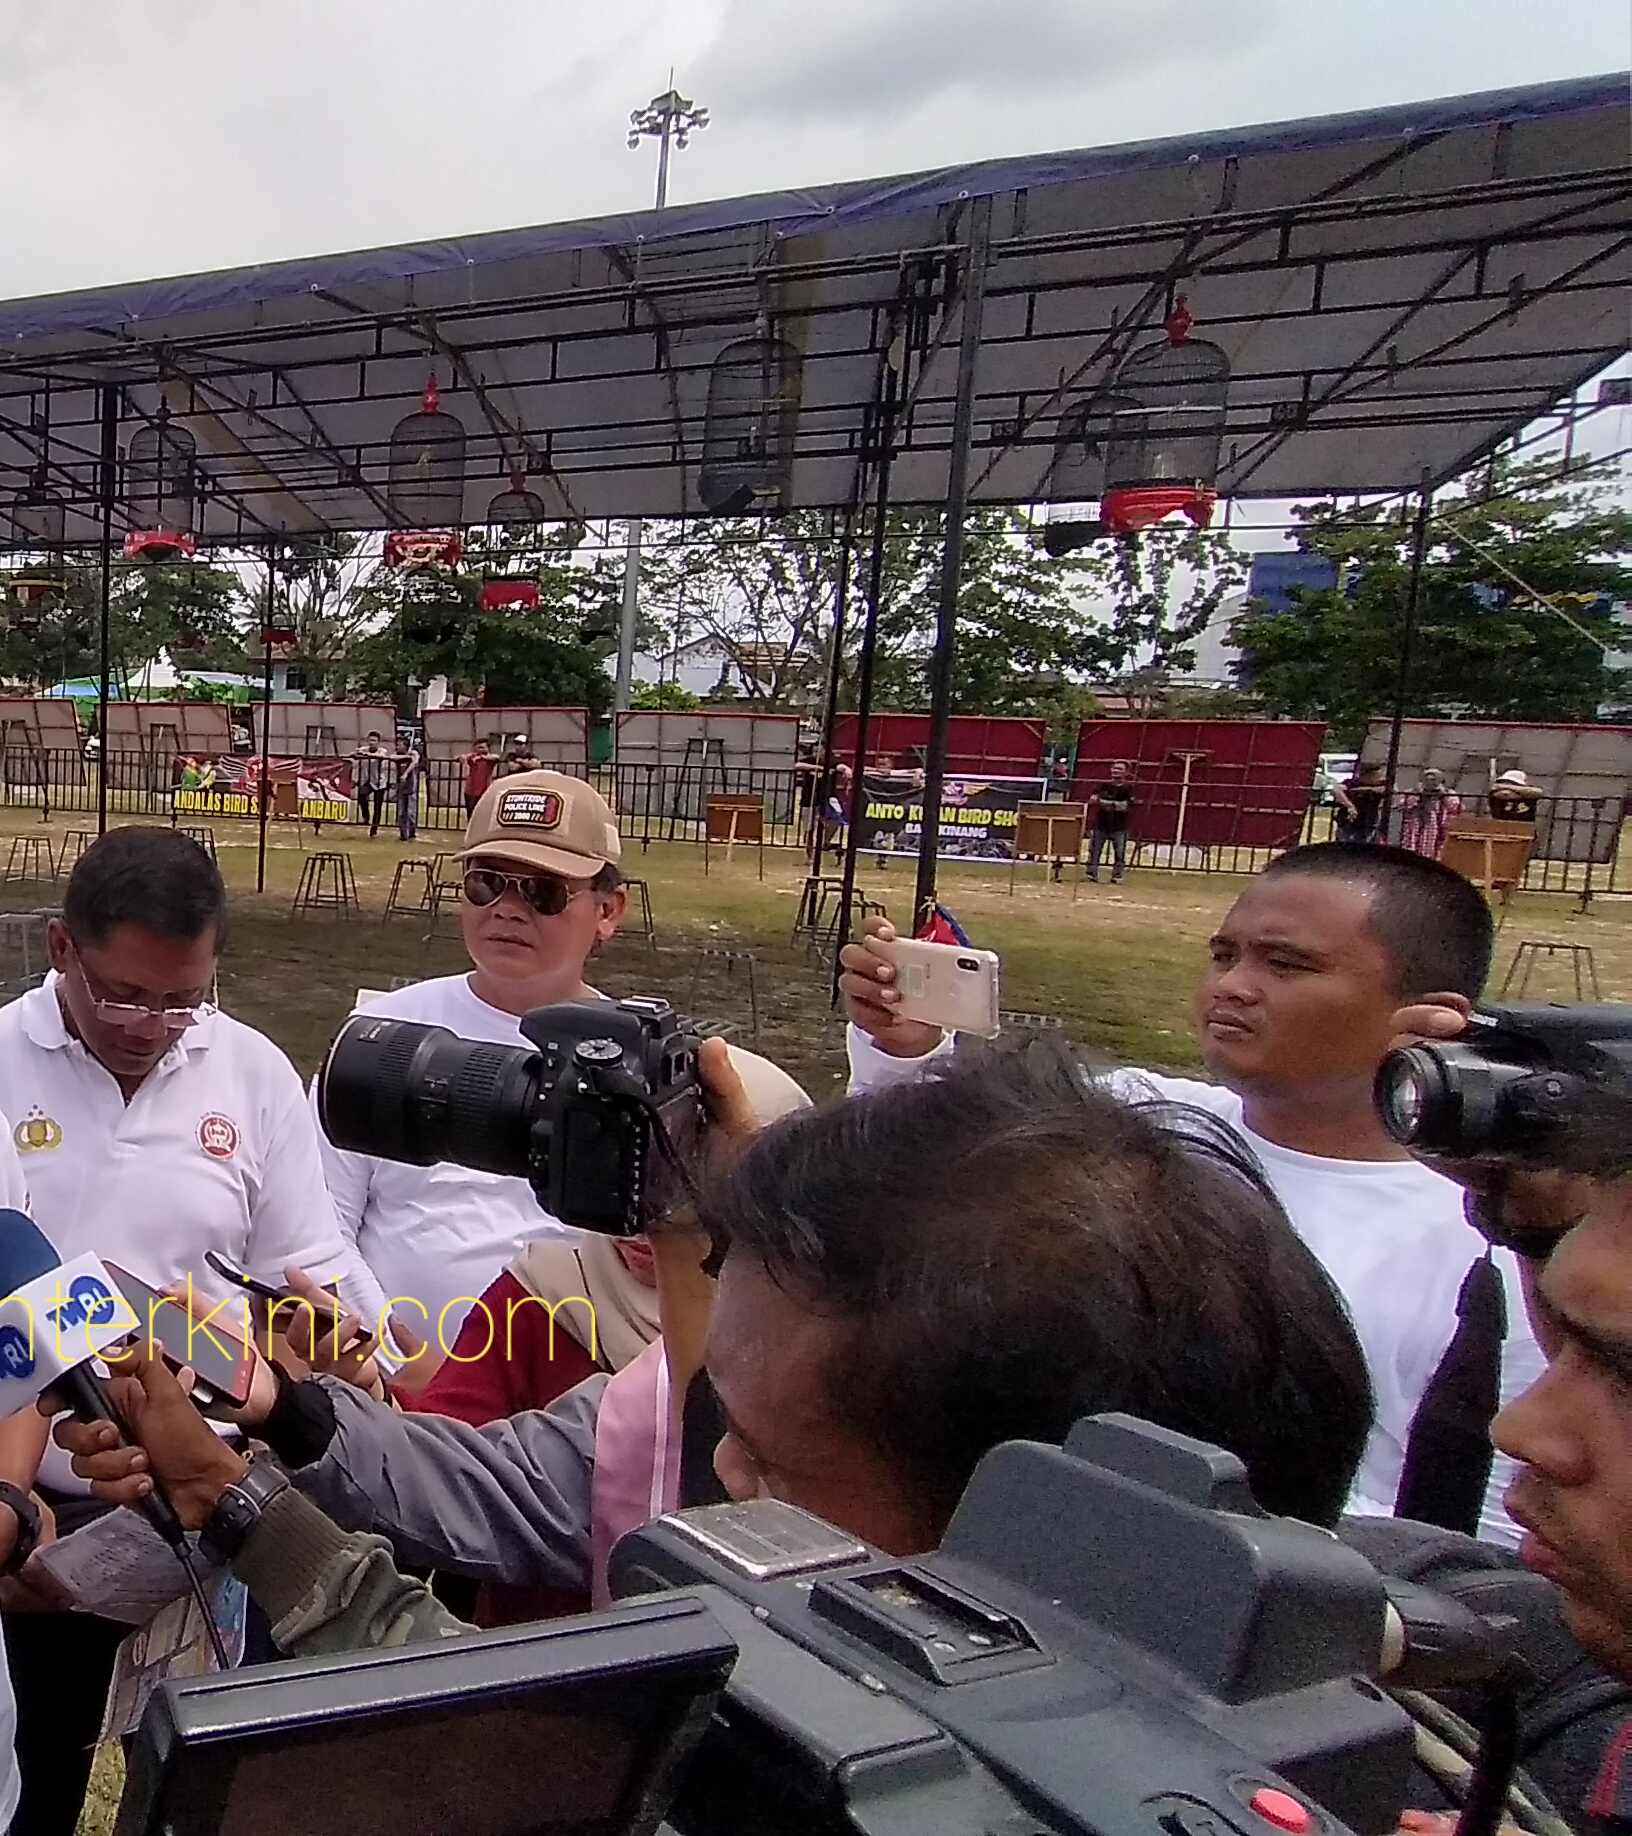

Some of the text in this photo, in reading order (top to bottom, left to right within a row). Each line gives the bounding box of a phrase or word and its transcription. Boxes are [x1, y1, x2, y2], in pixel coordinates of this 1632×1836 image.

[173, 790, 221, 811] ANDALAS
[223, 796, 248, 814] BIRD
[865, 802, 905, 820] ANTO
[958, 807, 992, 825] BIRD
